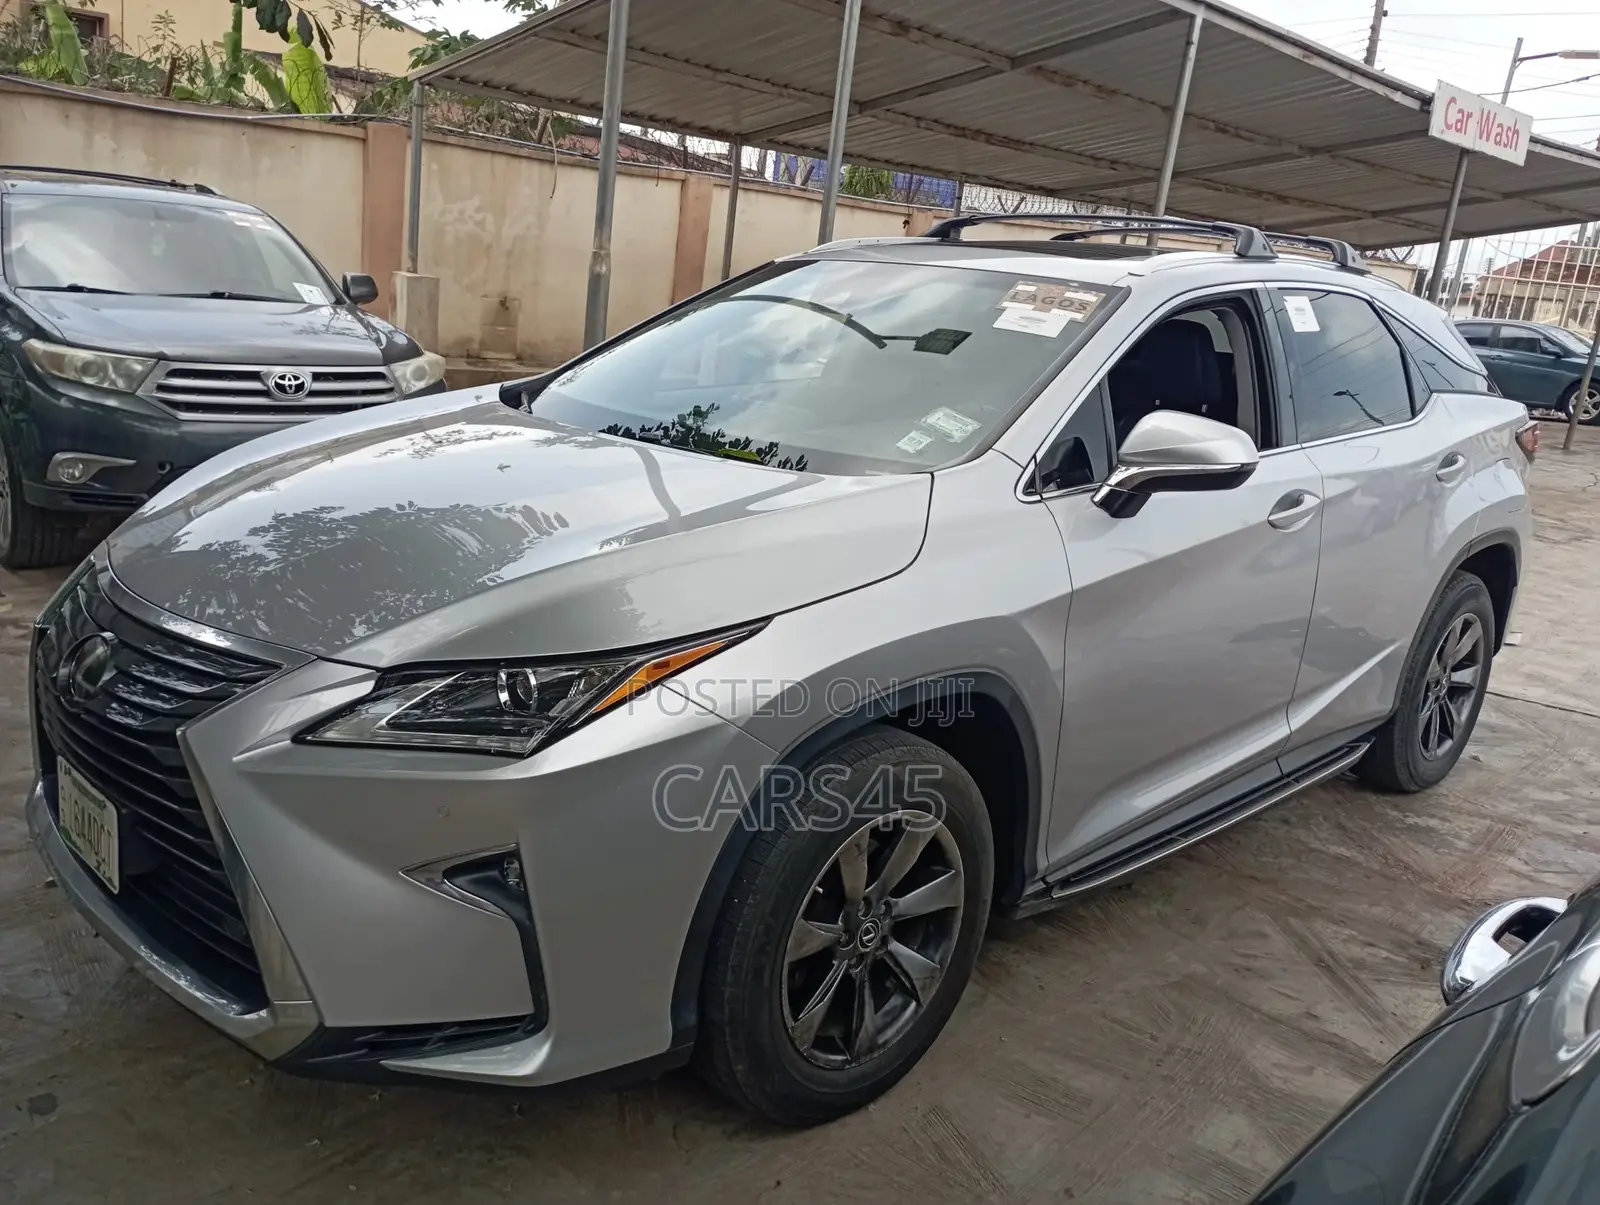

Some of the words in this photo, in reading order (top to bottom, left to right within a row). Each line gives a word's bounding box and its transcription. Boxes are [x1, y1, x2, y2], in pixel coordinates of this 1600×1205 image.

[1444, 96, 1473, 136] Car
[1477, 107, 1519, 152] Wash
[1010, 291, 1091, 312] LAGOS
